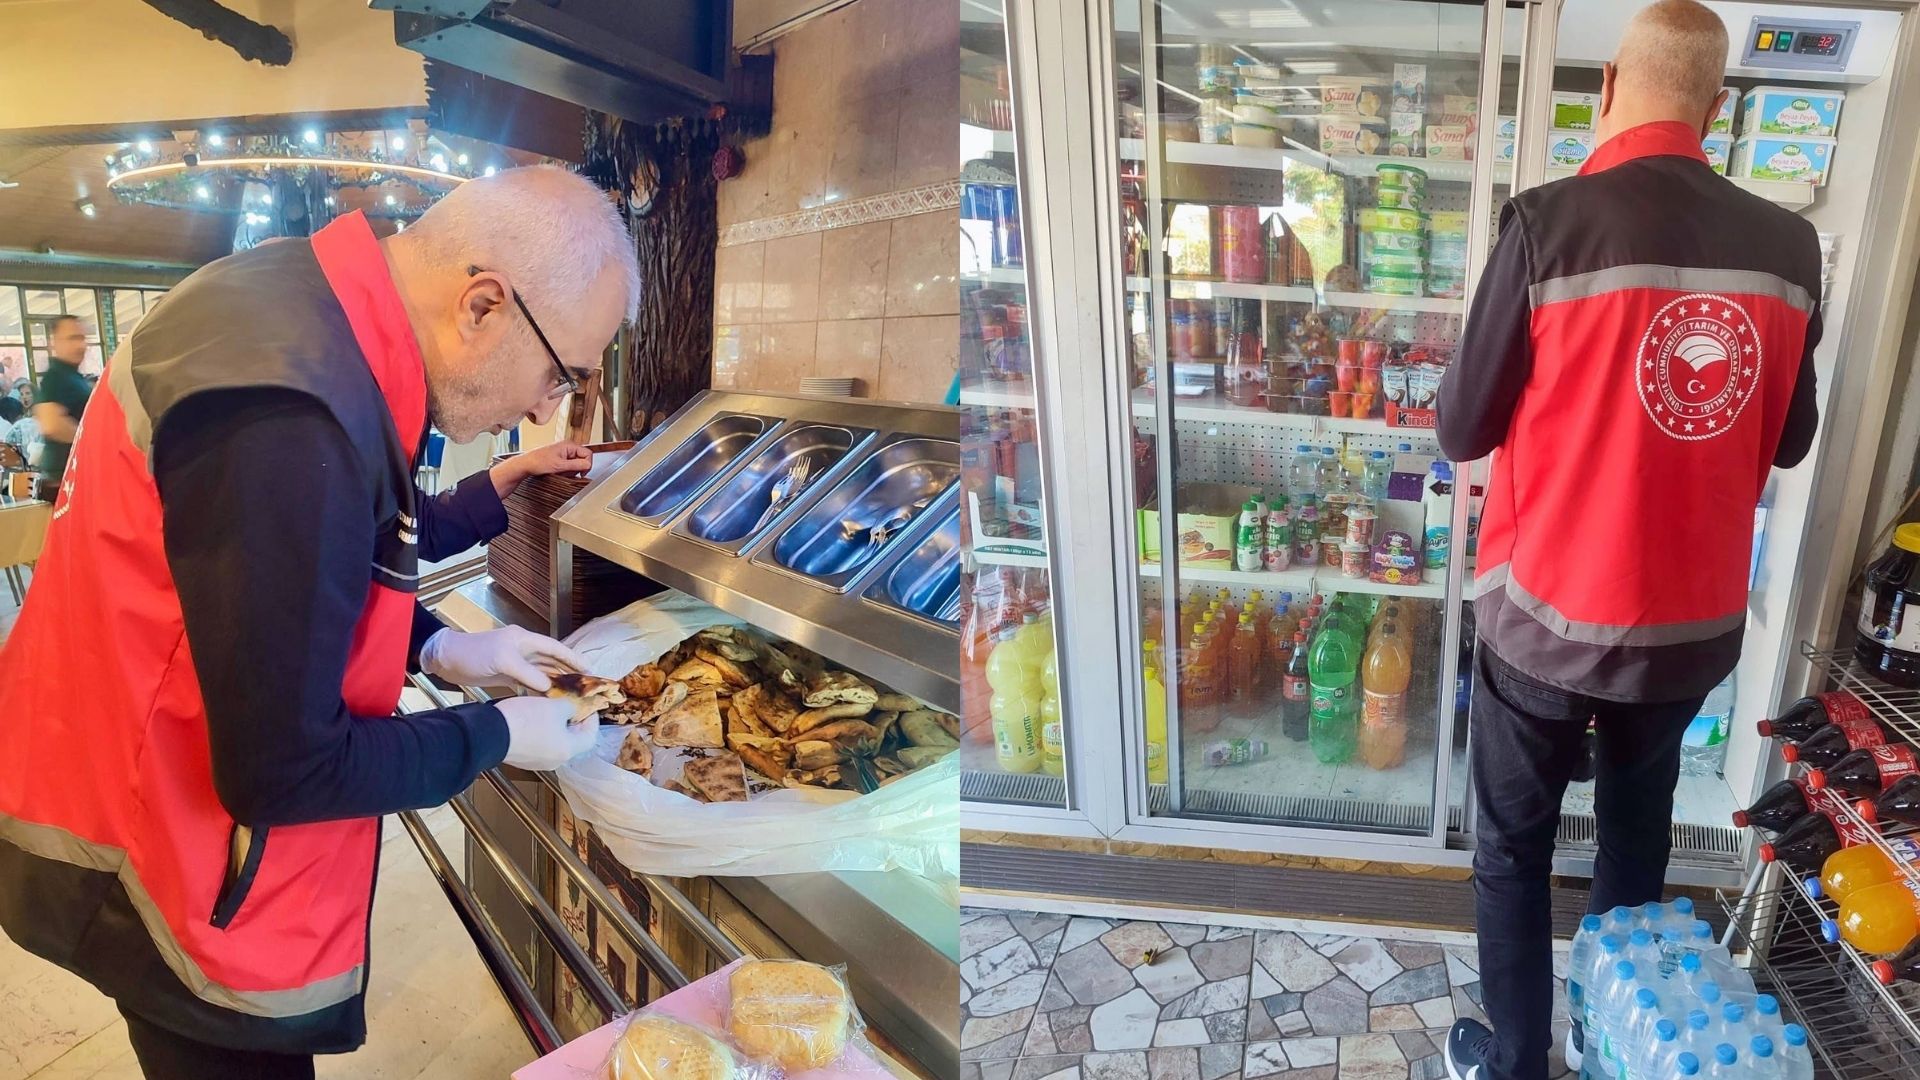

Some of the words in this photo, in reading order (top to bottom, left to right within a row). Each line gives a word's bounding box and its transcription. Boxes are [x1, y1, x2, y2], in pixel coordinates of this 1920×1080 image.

[1324, 87, 1356, 102] Sana
[1323, 125, 1355, 140] Sana
[1430, 127, 1465, 143] Sana
[1689, 321, 1718, 333] TARIM
[1719, 328, 1731, 341] VE
[1659, 323, 1687, 381] CUMHURİYETİ
[1728, 339, 1738, 374] ORMAN
[1700, 374, 1736, 414] BAKANLIĞI
[1429, 536, 1448, 548] Ayra
